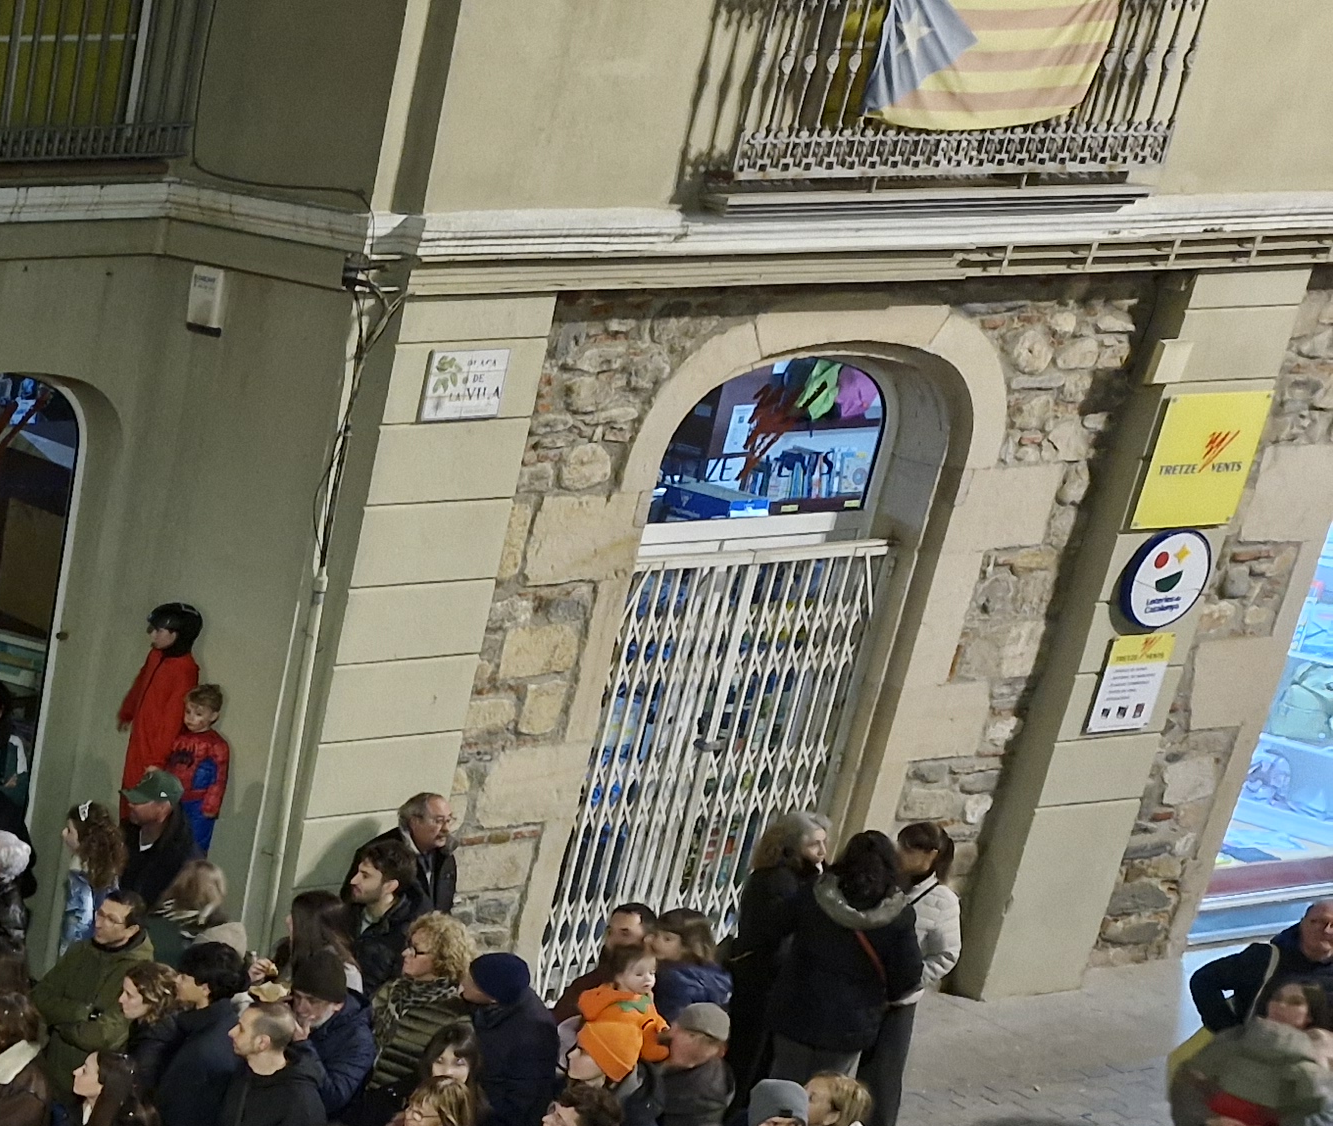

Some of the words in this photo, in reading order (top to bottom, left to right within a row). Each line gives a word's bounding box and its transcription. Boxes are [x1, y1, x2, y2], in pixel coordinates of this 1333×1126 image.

[472, 374, 485, 383] DE
[467, 386, 500, 400] VILA
[1159, 464, 1199, 475] TRETZE
[1211, 461, 1242, 473] VENTS
